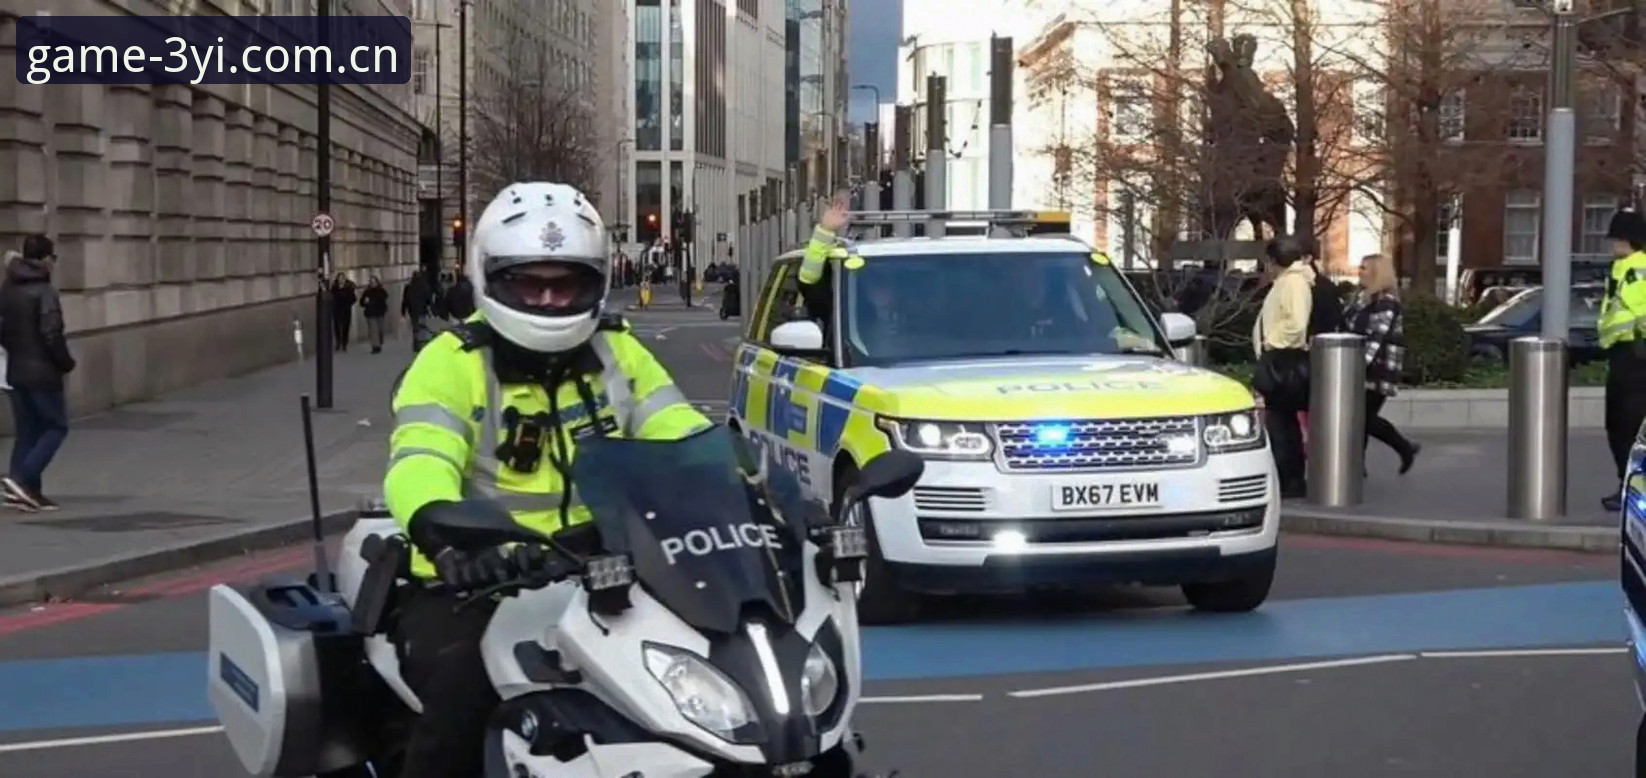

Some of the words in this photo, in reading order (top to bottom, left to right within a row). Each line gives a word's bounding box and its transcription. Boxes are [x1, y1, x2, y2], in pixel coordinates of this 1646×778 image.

[314, 219, 331, 231] 20
[996, 381, 1165, 395] POLICE
[1061, 485, 1114, 506] BX67
[1119, 483, 1159, 503] EVM
[660, 523, 783, 565] POLICE
